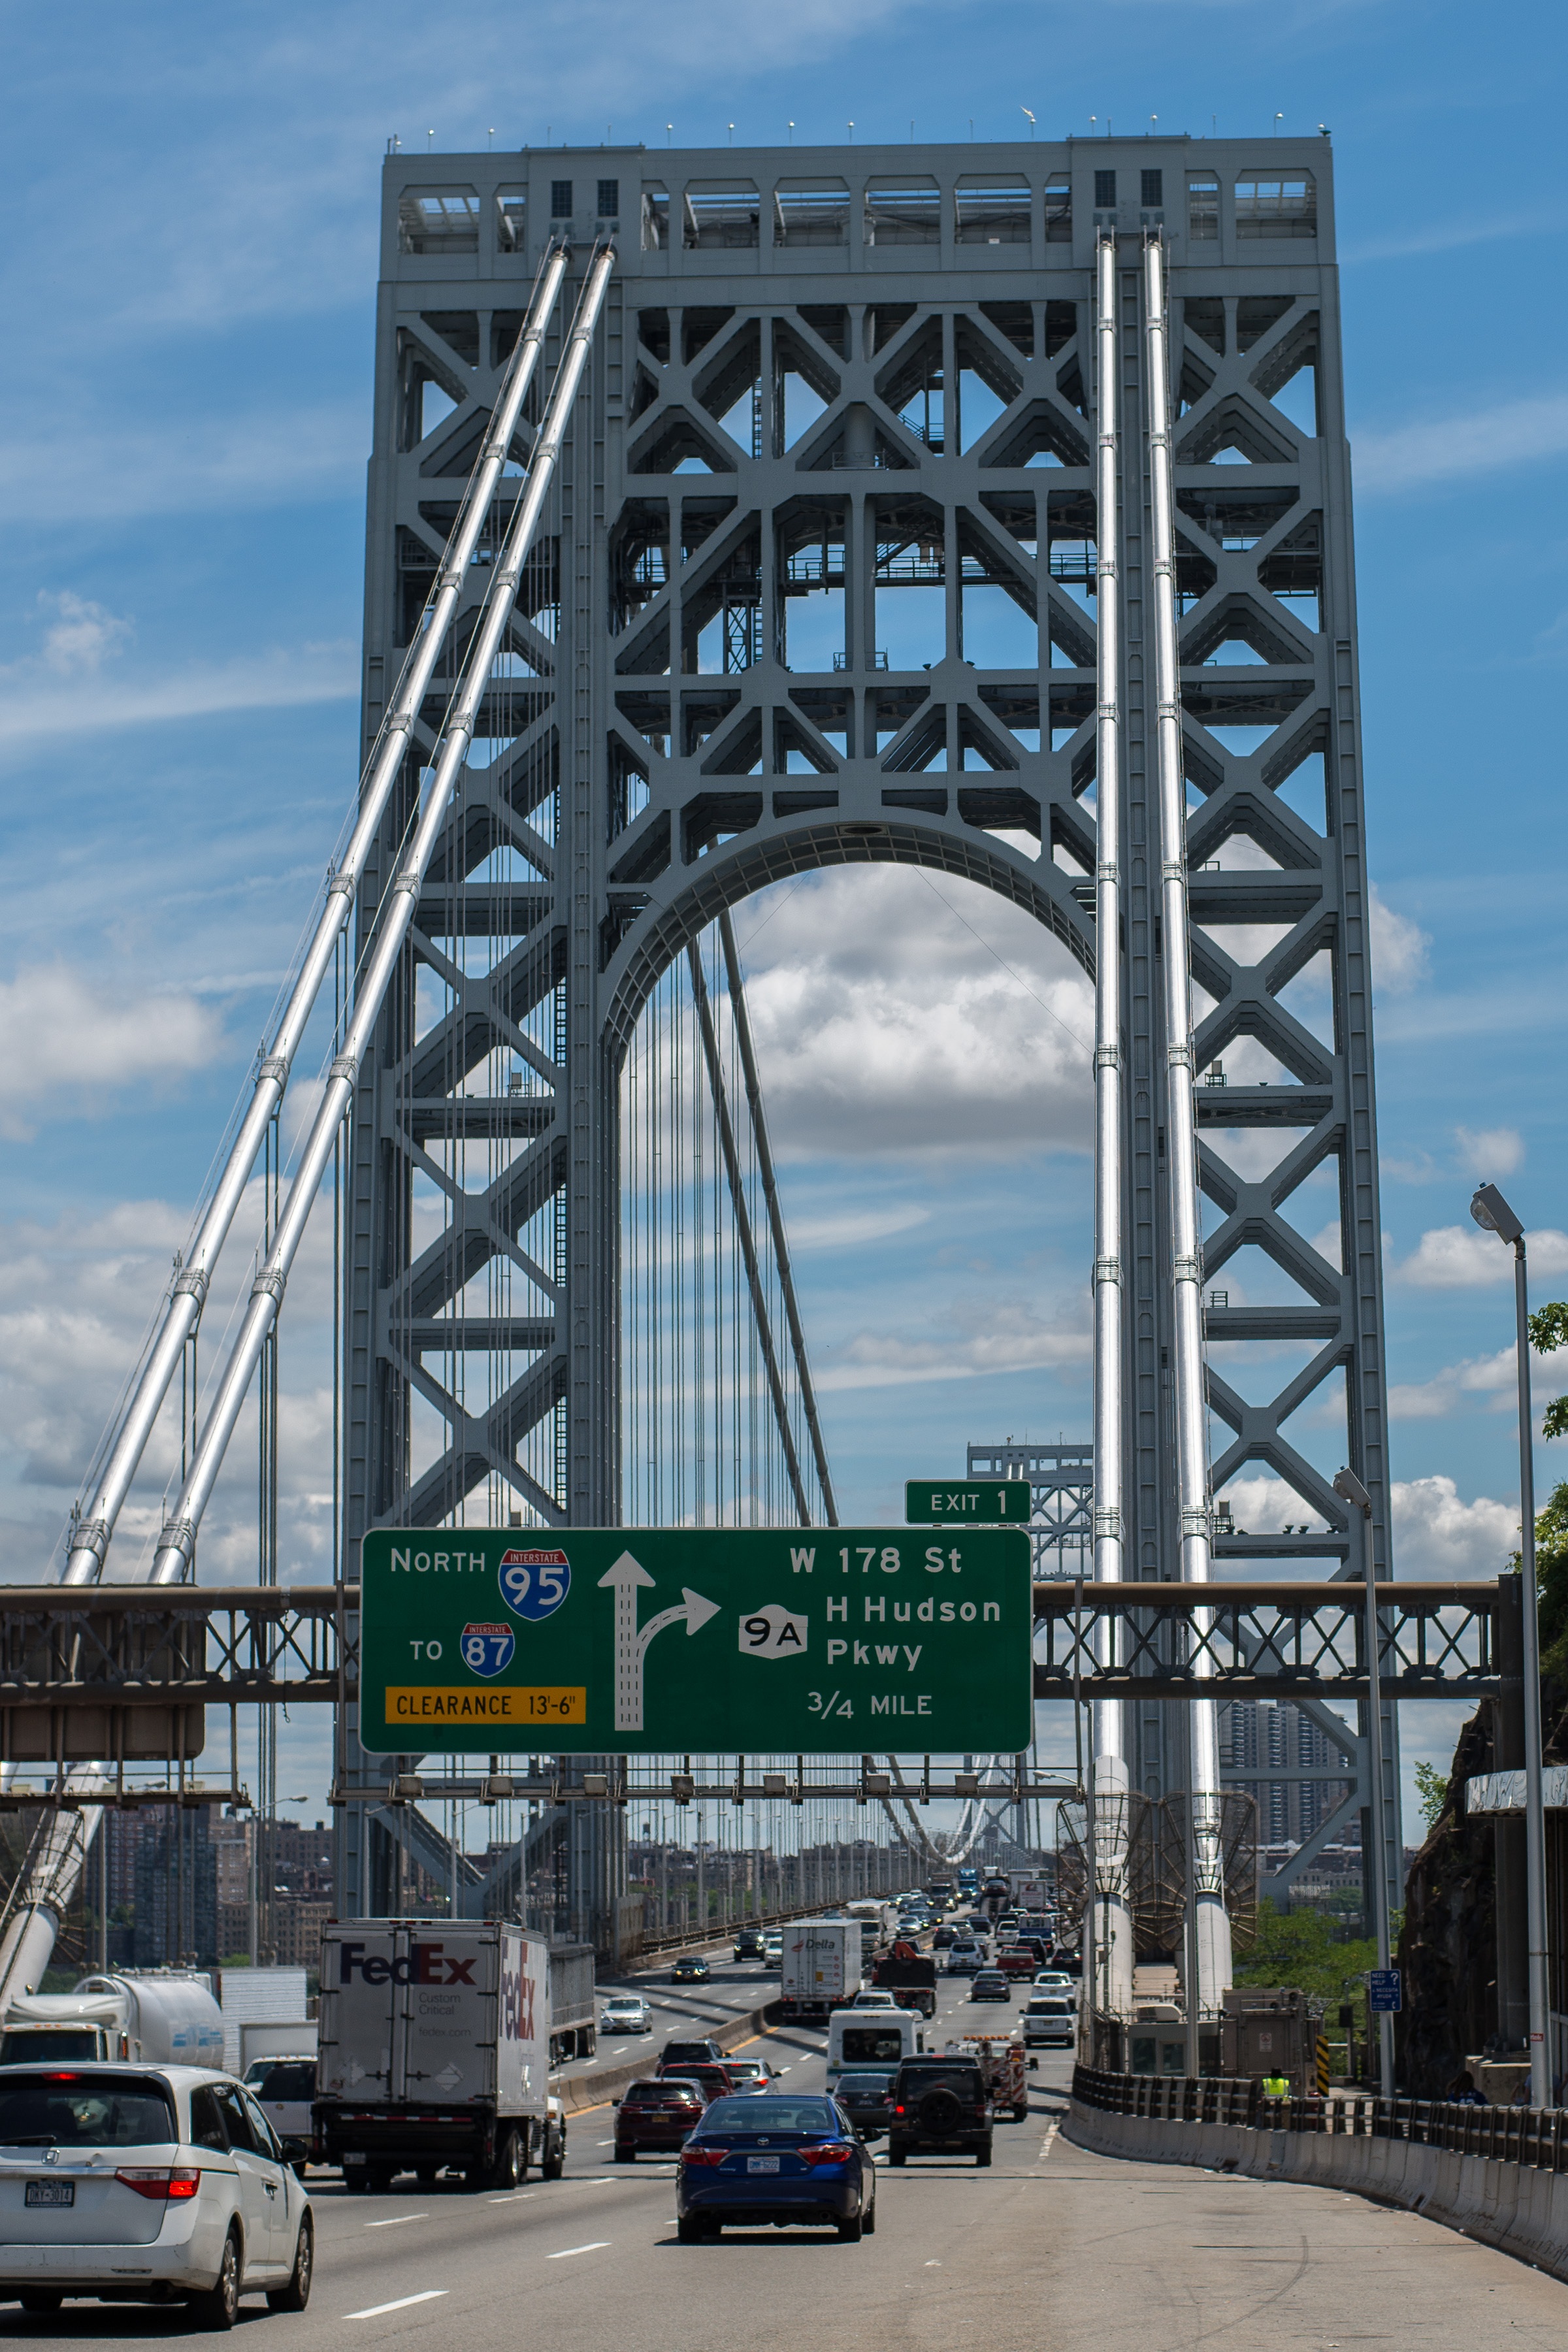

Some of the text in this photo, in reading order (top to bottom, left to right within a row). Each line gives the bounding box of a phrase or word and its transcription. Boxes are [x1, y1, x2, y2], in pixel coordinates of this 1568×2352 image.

[932, 1490, 1005, 1514] EXIT 1
[391, 1548, 485, 1572] NORTH
[510, 1554, 559, 1563] INTERSTATE
[790, 1546, 961, 1573] W 178 St
[505, 1567, 564, 1605] 95
[826, 1596, 1000, 1622] H Hudson
[744, 1617, 802, 1646] 9A
[410, 1641, 442, 1660] TO
[467, 1637, 510, 1666] 87
[827, 1639, 923, 1671] Pkwy
[397, 1695, 512, 1715] CLEARANCE
[808, 1691, 932, 1720] 3/4 MILE
[806, 1938, 835, 1950] Delta
[340, 1942, 478, 1986] FedEx
[419, 1993, 461, 2004] Custom
[500, 1936, 535, 2041] FedEx
[419, 2004, 455, 2016] Critical
[419, 2026, 471, 2037] fedex.com
